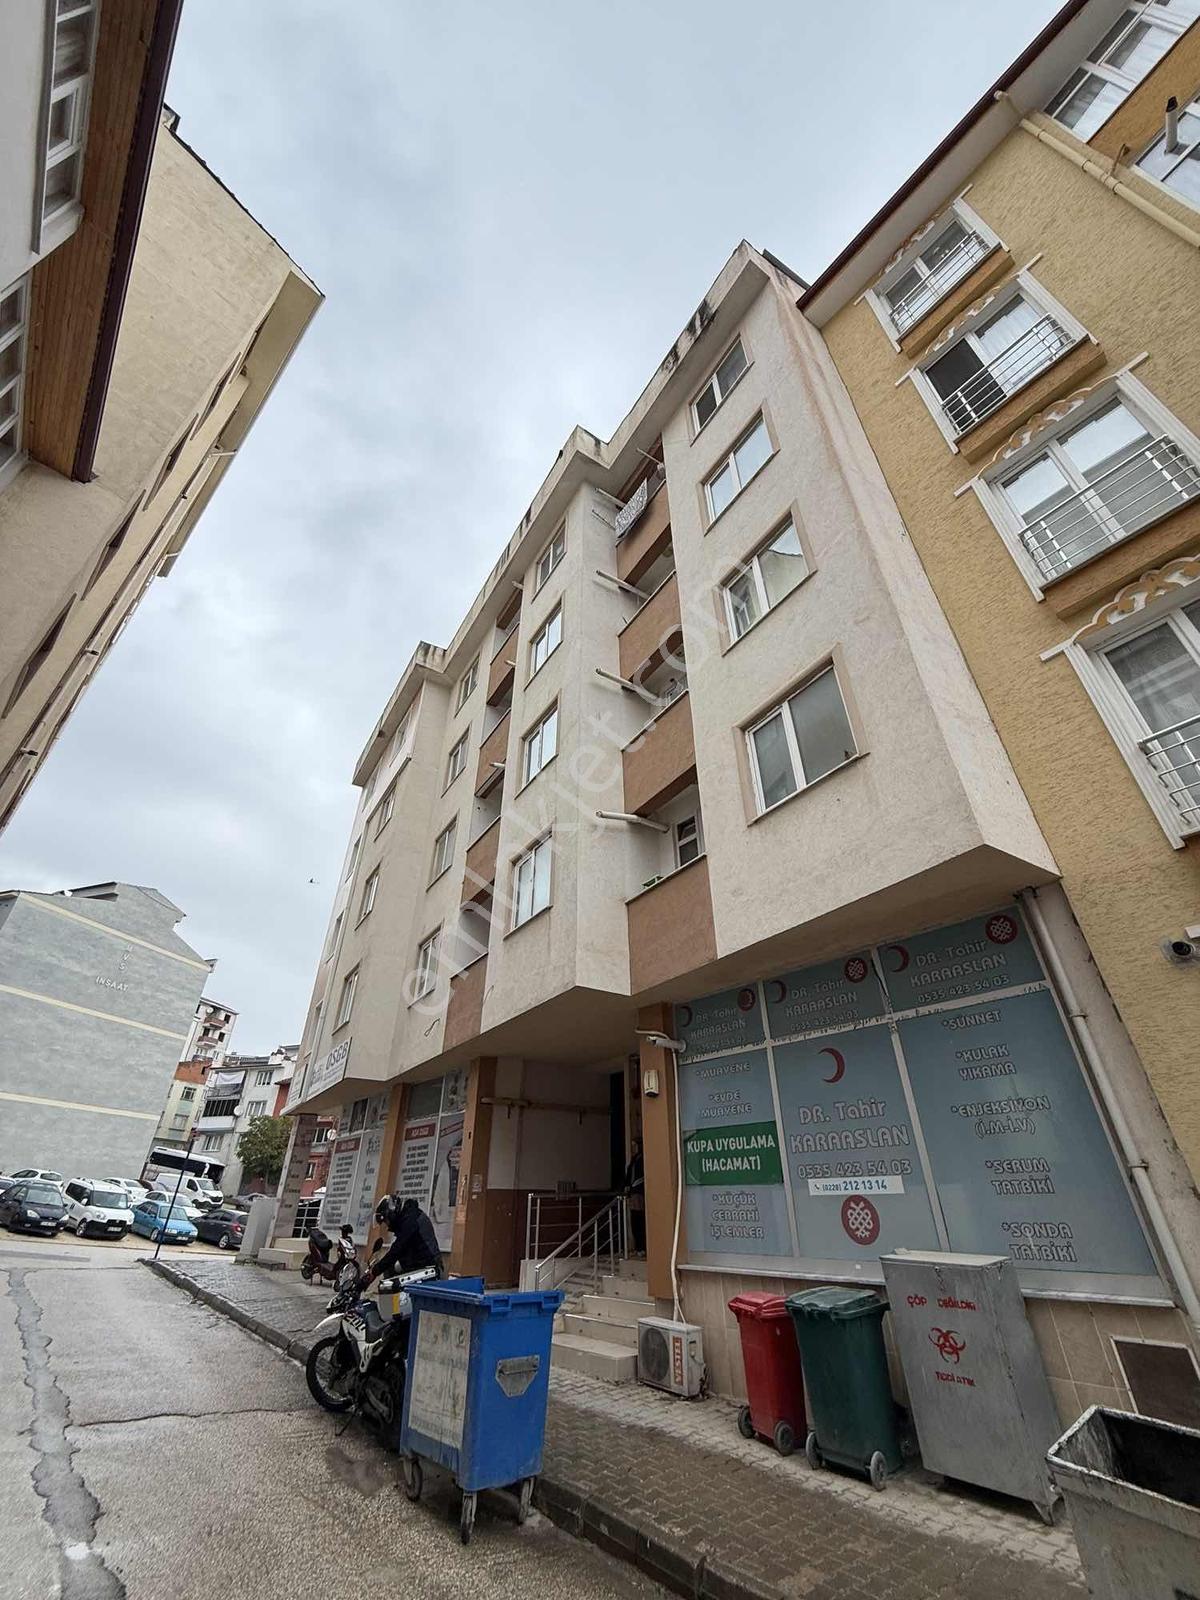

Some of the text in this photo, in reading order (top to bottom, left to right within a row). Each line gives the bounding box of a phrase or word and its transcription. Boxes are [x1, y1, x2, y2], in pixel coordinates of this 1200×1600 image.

[916, 940, 987, 968] DR. Tahir
[910, 953, 1007, 988] KARAASLAN
[918, 975, 1010, 1003] 0535 423 54 03
[785, 991, 859, 1018] KARAASLAN
[959, 1061, 1017, 1080] YIKAMA
[701, 1103, 753, 1119] MUAYENE
[799, 1097, 887, 1124] DR. Tahir
[687, 1134, 776, 1153] KUPA UYGULAMA
[790, 1123, 911, 1154] KARAASLAN
[702, 1155, 761, 1173] (HACAMAT)
[798, 1157, 913, 1180] 0535 423 54 03
[843, 1180, 860, 1191] 212
[862, 1180, 874, 1190] 13
[875, 1179, 888, 1190] 14
[991, 1174, 1056, 1195] TATBİKİ
[1009, 1240, 1078, 1262] TATBİKİ
[906, 1294, 928, 1308] ÇÖP
